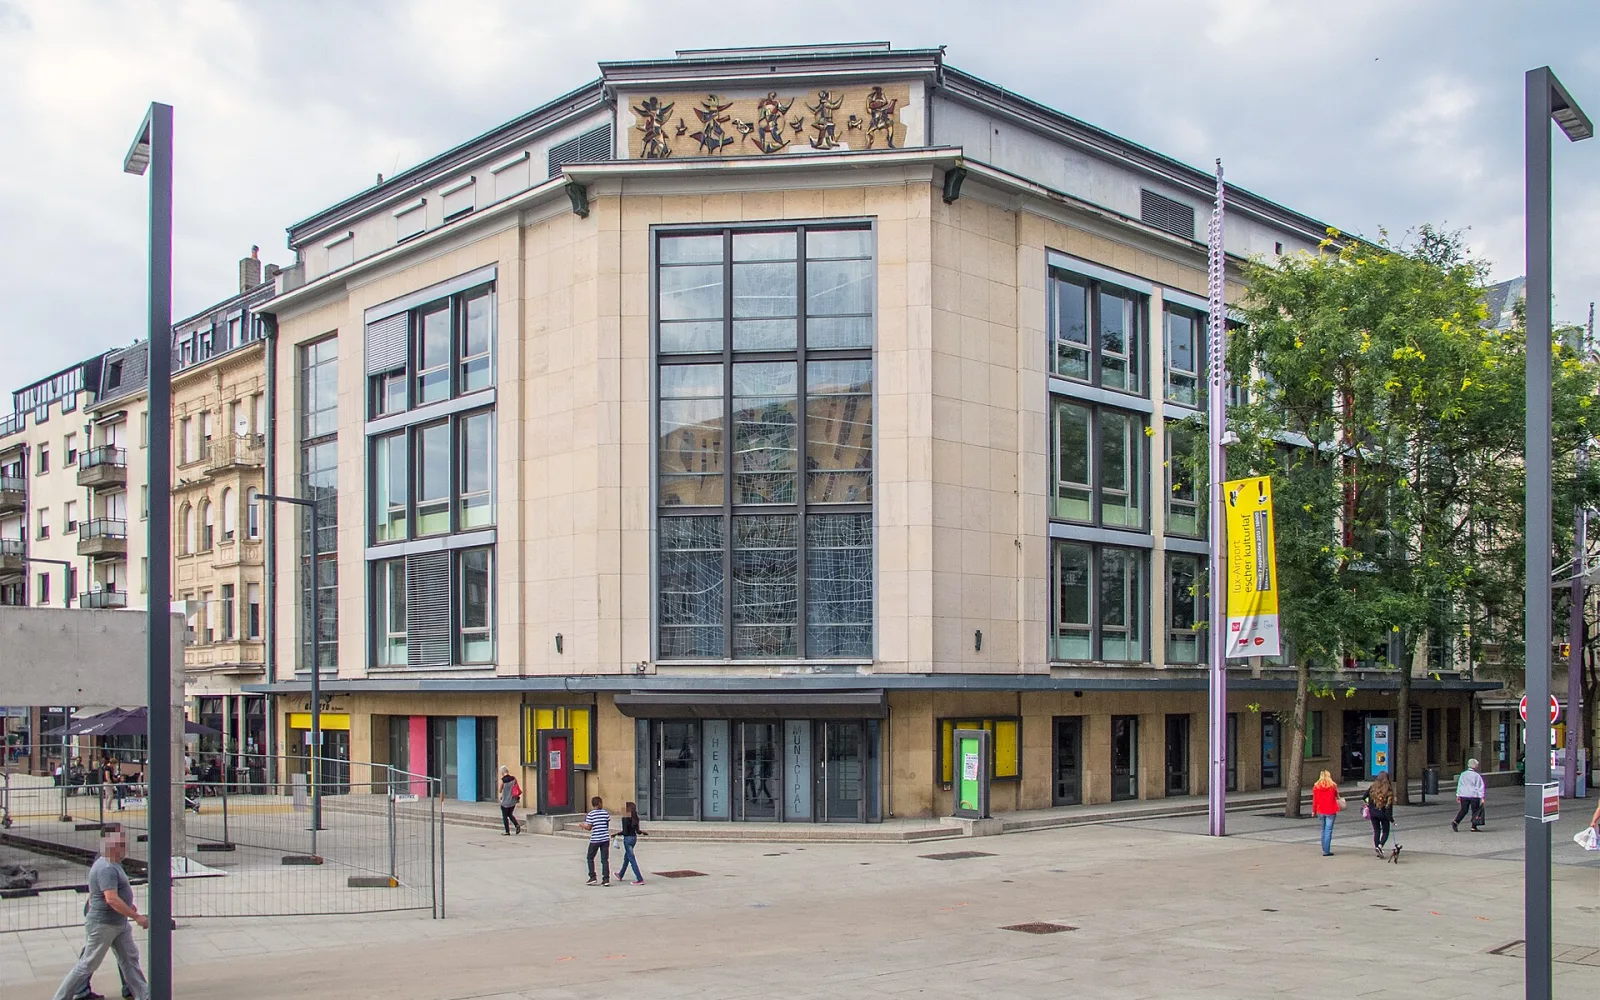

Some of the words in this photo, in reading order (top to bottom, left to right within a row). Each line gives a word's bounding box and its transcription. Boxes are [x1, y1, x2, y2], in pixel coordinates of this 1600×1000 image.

[1241, 513, 1251, 557] kulturlaf
[1233, 540, 1242, 593] lux-Airport
[1244, 561, 1252, 593] escher
[793, 725, 801, 813] MUNICIPAL
